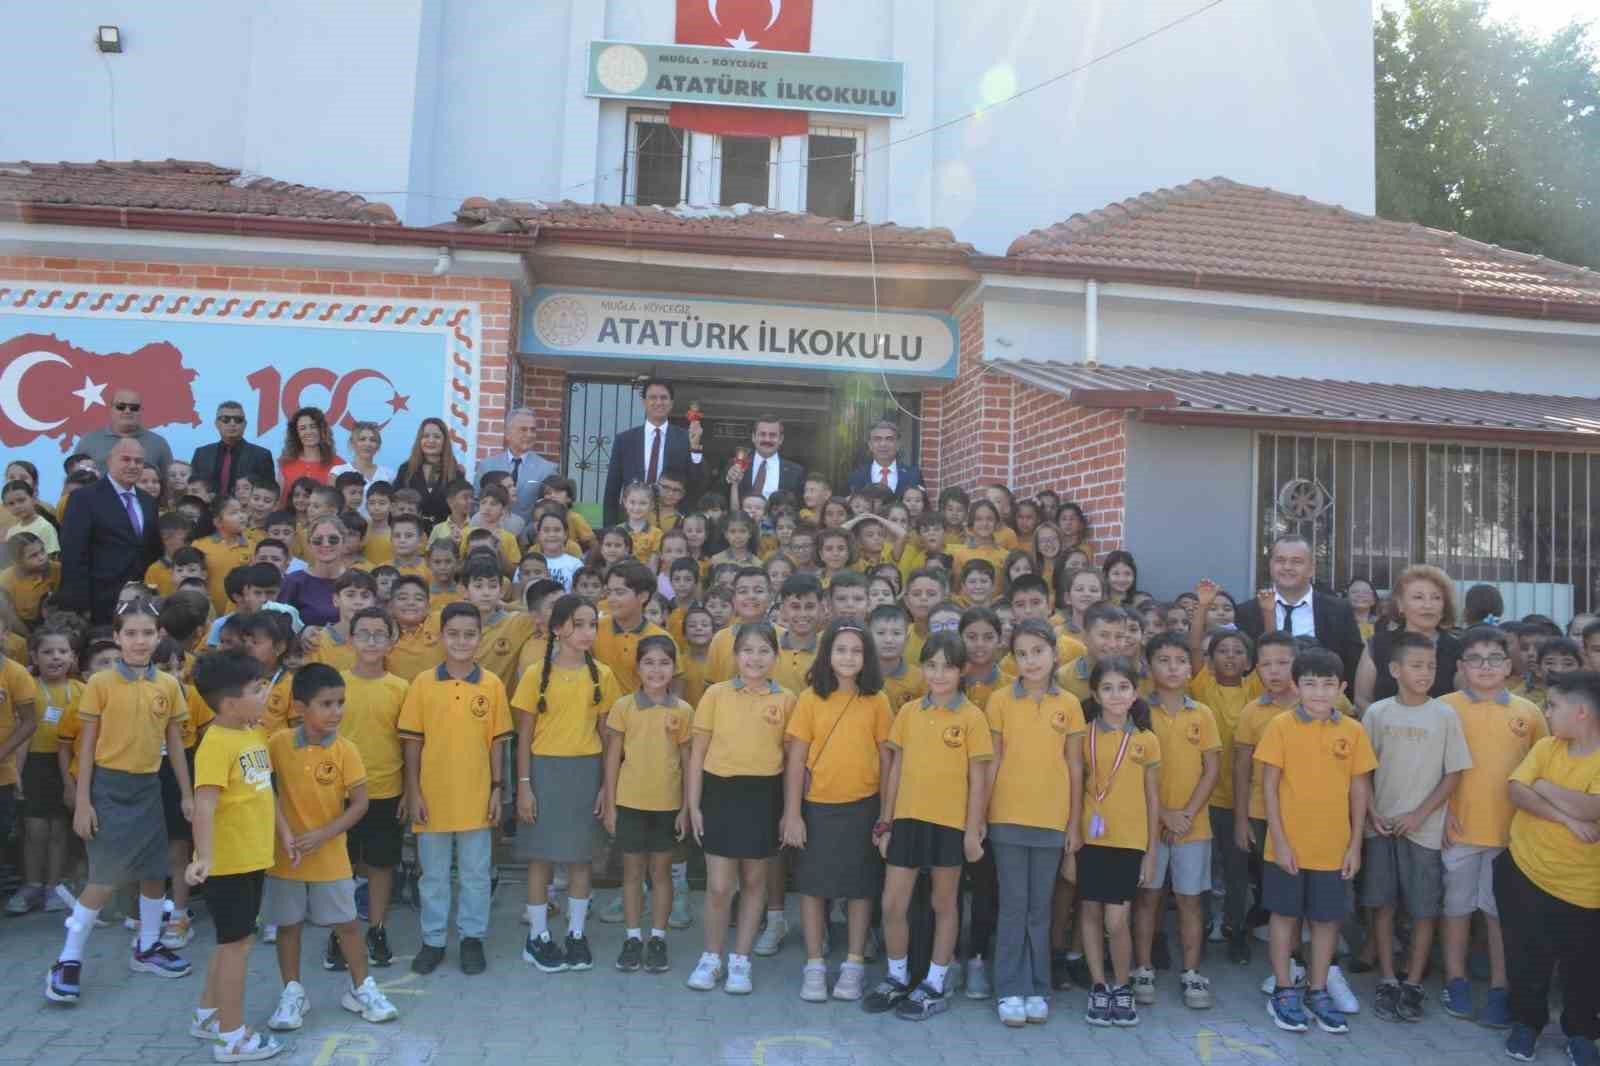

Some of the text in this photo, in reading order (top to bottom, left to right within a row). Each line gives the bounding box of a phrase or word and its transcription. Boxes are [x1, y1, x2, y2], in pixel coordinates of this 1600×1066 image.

[655, 74, 897, 108] ATATÜRK İLKOKULU
[597, 316, 923, 362] ATATÜRK İLKOKULU
